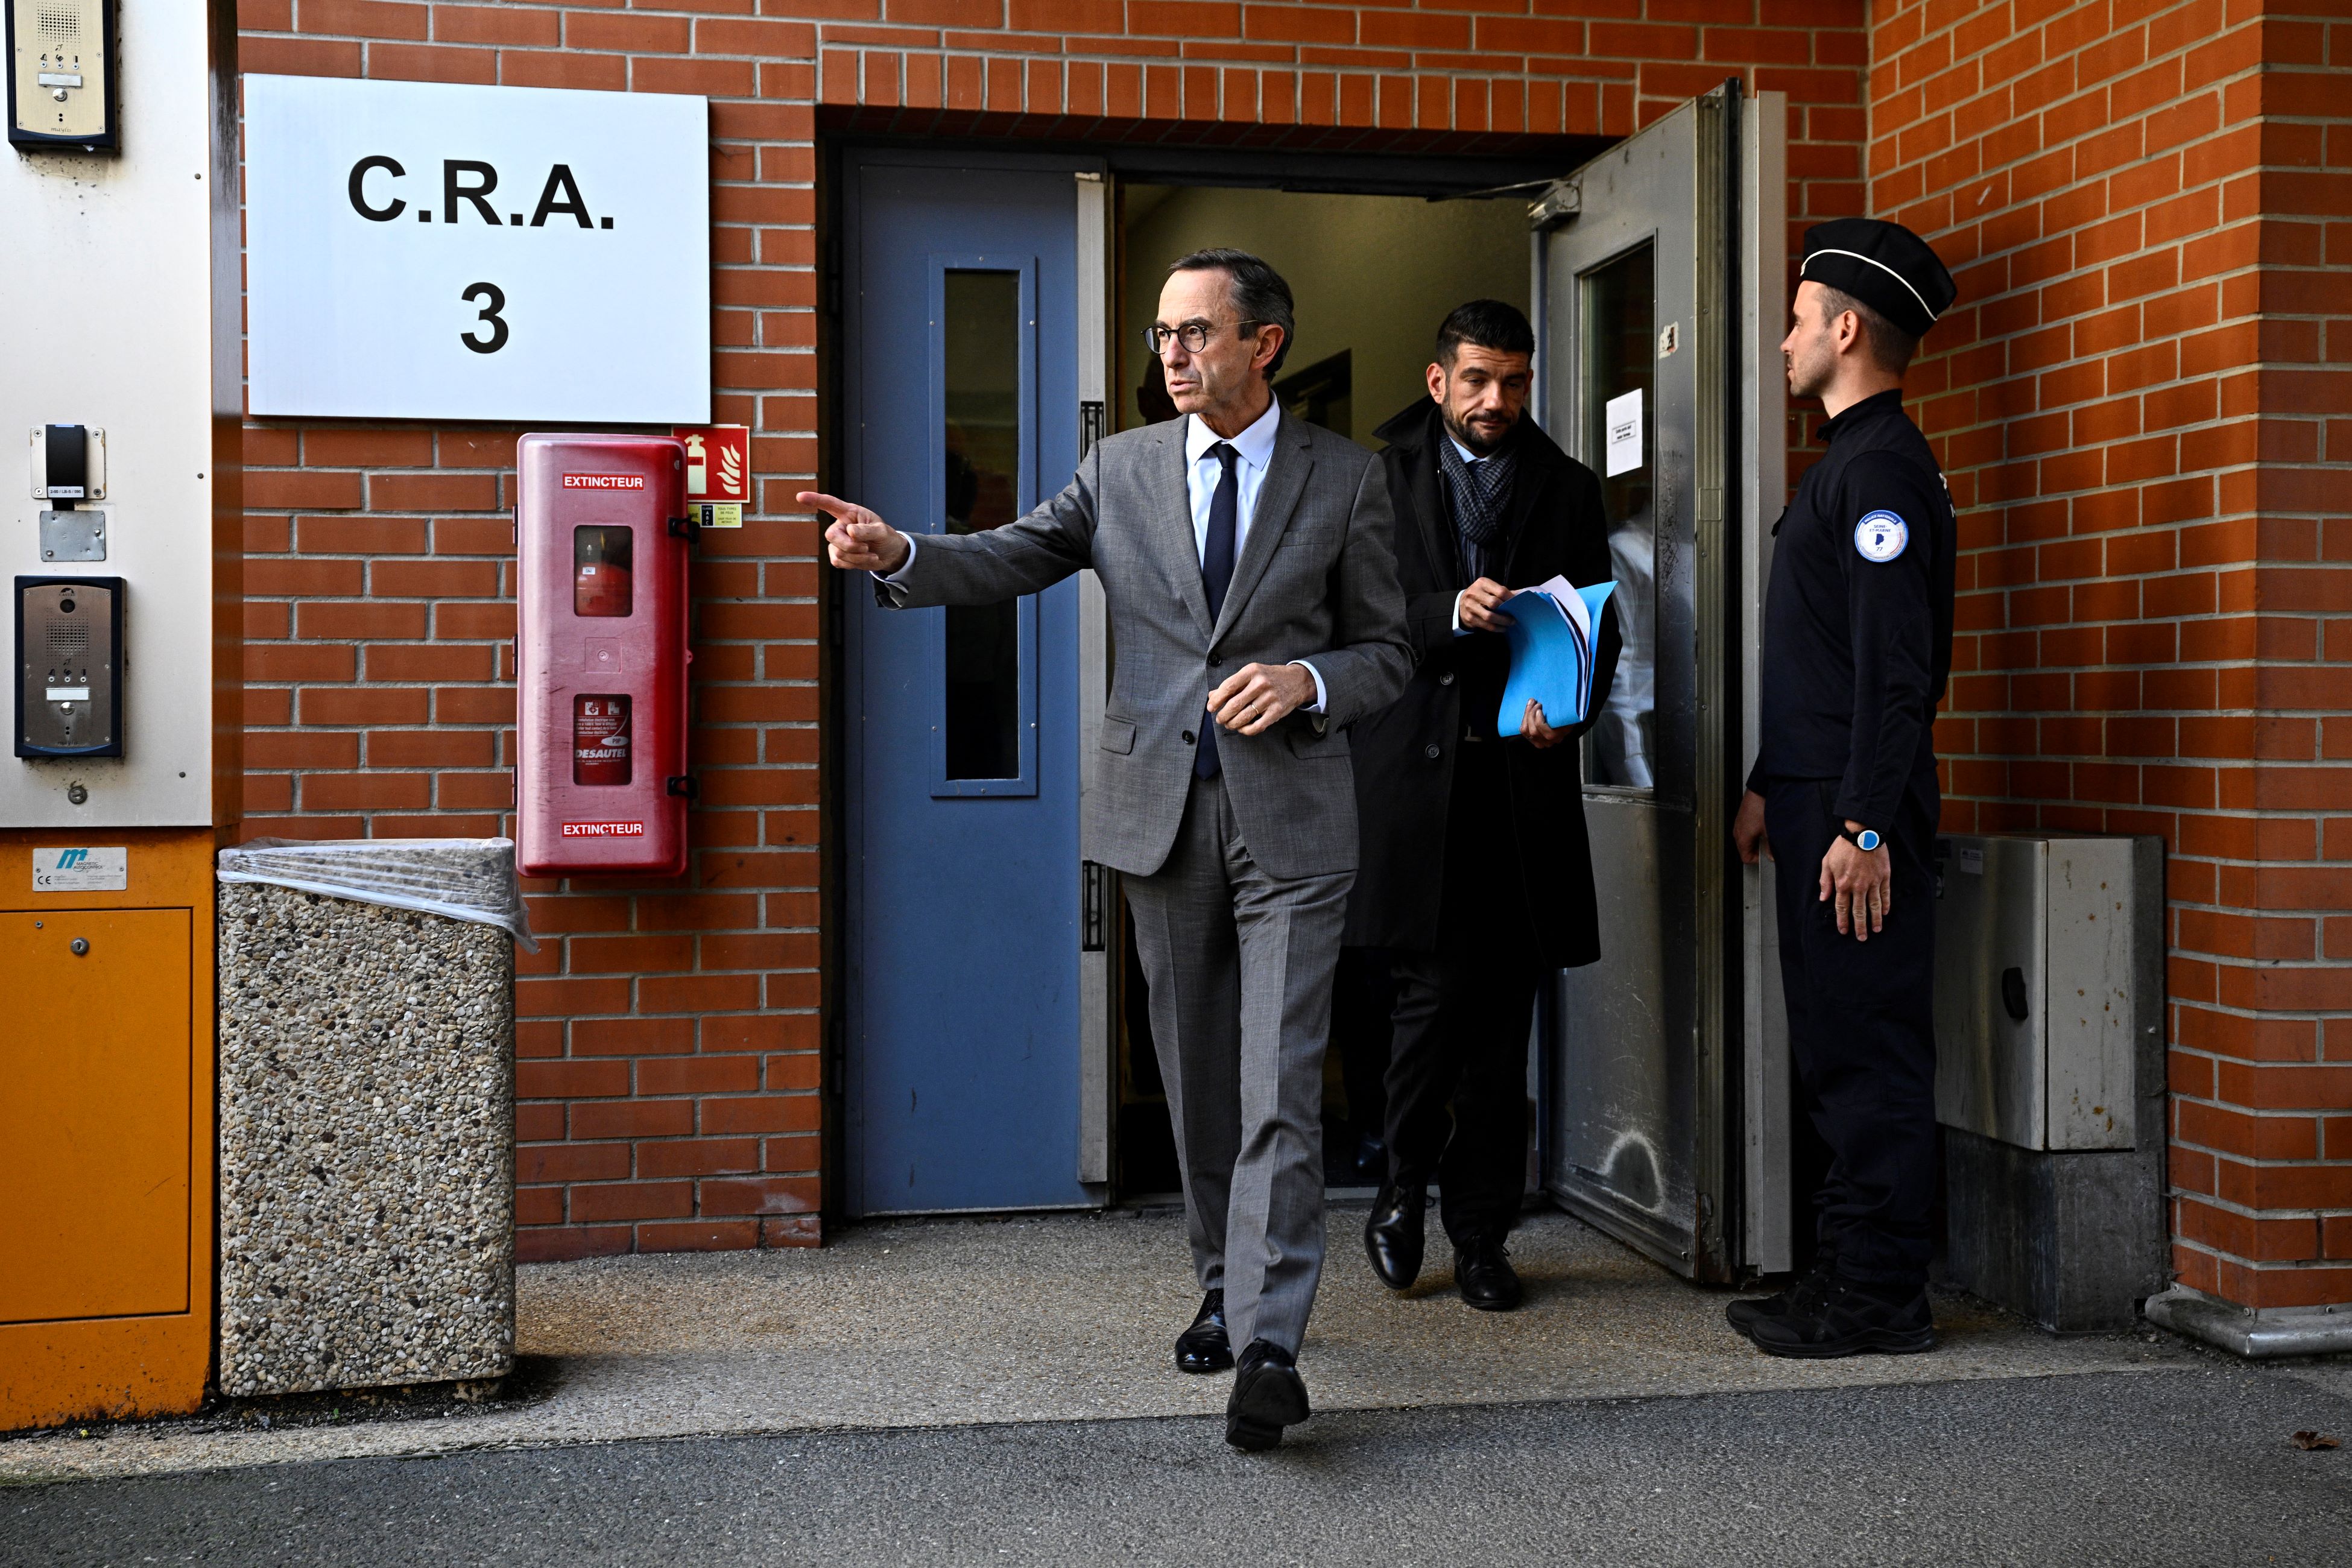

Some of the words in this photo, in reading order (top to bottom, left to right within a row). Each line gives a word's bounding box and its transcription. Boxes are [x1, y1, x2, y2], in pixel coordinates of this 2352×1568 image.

[348, 155, 614, 230] C.R.A.
[460, 282, 509, 354] 3
[564, 476, 643, 487] EXTINCTEUR
[575, 748, 627, 758] DESAUTEL
[563, 823, 642, 835] EXTINCTEUR
